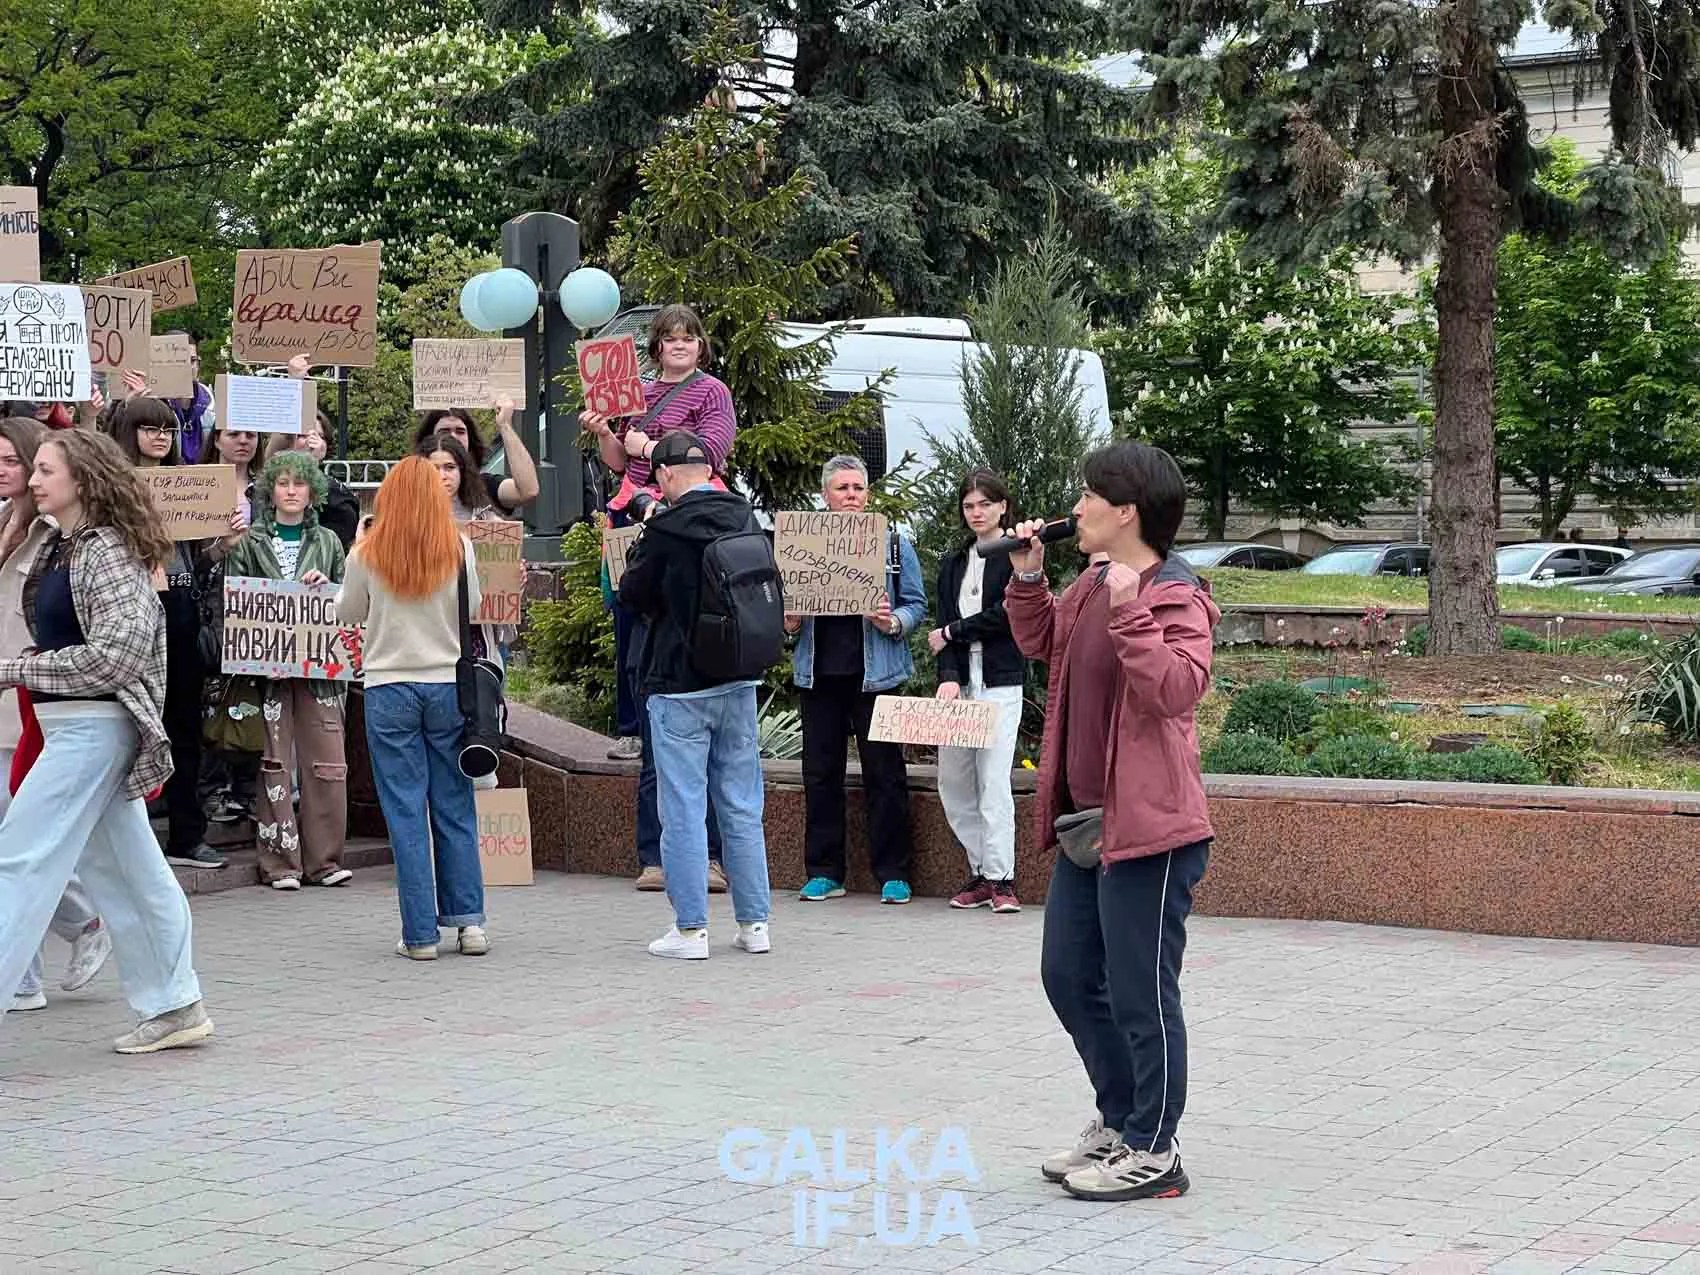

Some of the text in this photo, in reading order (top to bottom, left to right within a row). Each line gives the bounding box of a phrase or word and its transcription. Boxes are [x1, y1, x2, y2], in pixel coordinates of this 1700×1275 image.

[242, 255, 302, 296] АБИ
[83, 292, 146, 335] РОТИ
[50, 322, 84, 345] ПРОТИ
[90, 329, 124, 367] 50
[580, 337, 638, 384] СТОП
[780, 514, 876, 537] ДИСКРИМІ
[780, 544, 875, 587] ДОЗВОЛЕНА
[826, 537, 879, 559] НАЦІЯ
[225, 590, 296, 626] ДИЯВОЛ
[224, 626, 342, 667] НОВИЙ ЦК
